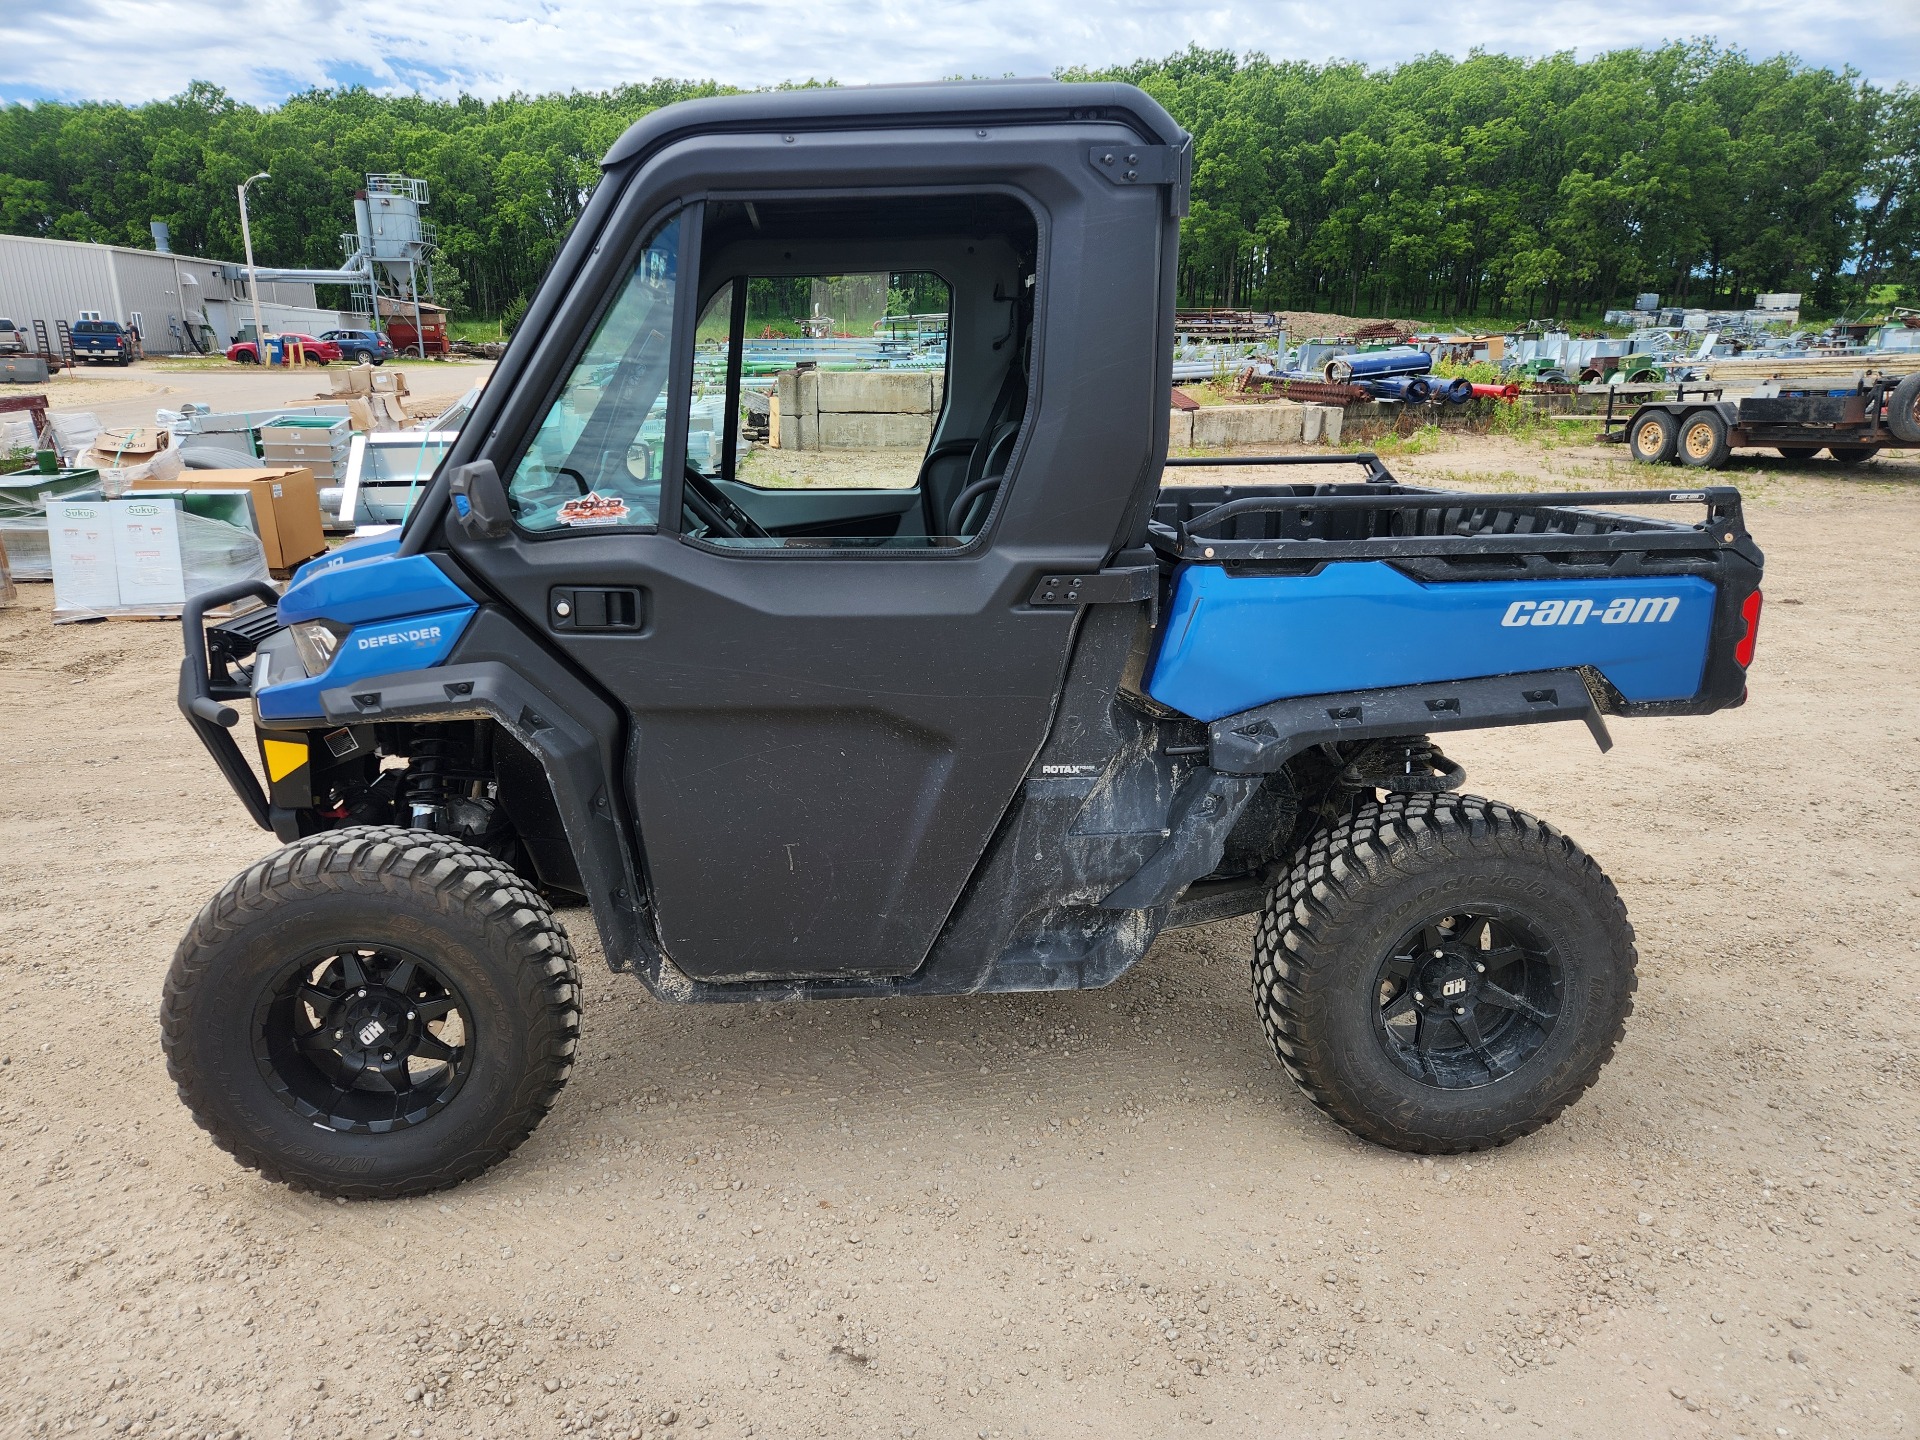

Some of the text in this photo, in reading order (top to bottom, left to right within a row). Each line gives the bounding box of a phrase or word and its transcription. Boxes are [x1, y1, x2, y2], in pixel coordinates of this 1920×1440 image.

[129, 505, 159, 515] Sukup
[564, 499, 622, 510] BOLD
[65, 508, 95, 519] Sukup
[1501, 596, 1680, 627] can-am
[358, 626, 441, 650] DEFENDER
[1042, 765, 1080, 774] ROTAX
